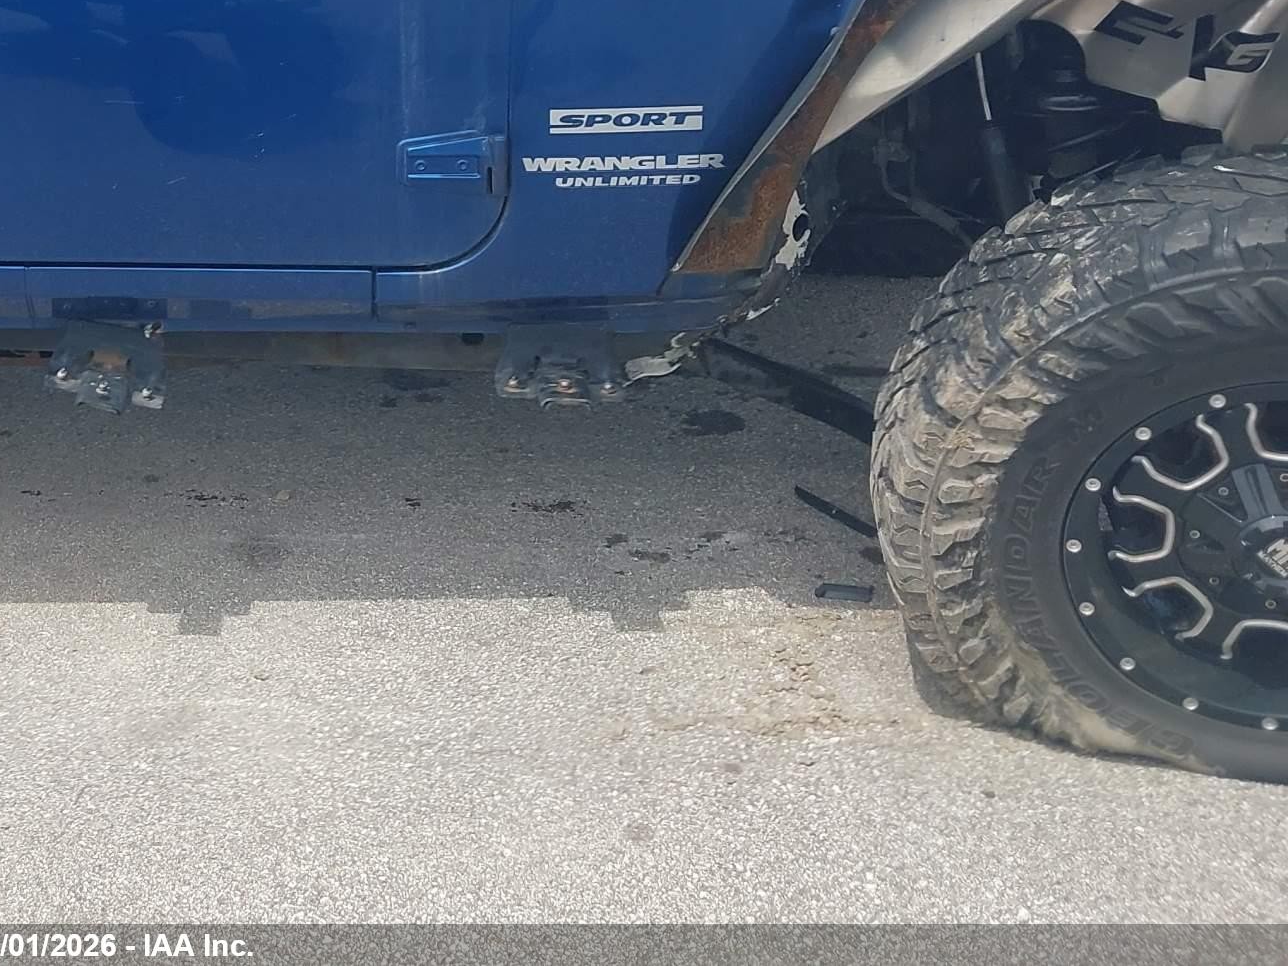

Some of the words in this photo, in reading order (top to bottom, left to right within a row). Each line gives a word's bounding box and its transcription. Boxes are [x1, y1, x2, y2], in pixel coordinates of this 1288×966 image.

[556, 110, 698, 130] SPORT
[521, 153, 727, 173] WRANGLER
[555, 174, 701, 188] UNLIMITED
